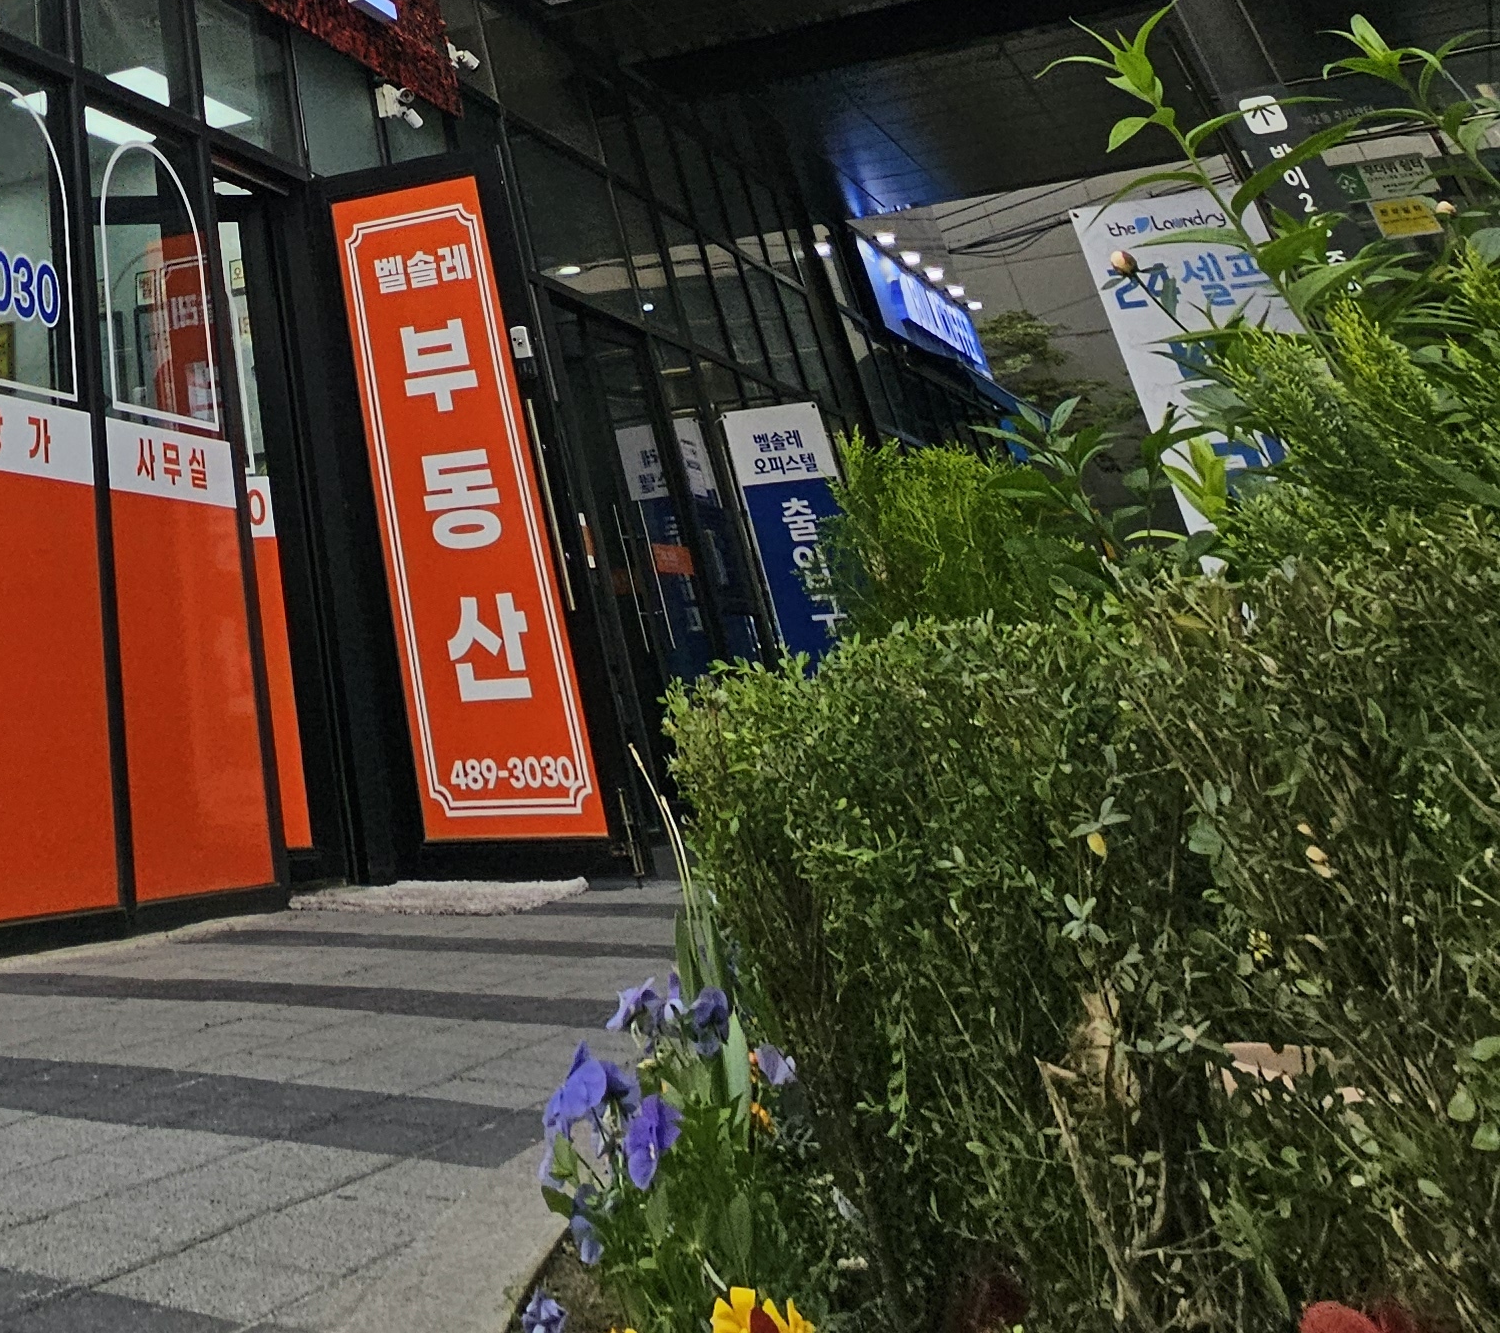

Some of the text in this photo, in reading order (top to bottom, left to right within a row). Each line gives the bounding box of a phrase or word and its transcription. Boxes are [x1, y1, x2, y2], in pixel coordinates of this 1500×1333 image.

[1106, 209, 1227, 237] the Laundry
[373, 242, 474, 294] 벨솔레
[753, 429, 803, 453] 벨솔레
[136, 437, 208, 490] 사무실
[754, 452, 819, 475] 오피스텔
[450, 755, 577, 792] 489-3030
